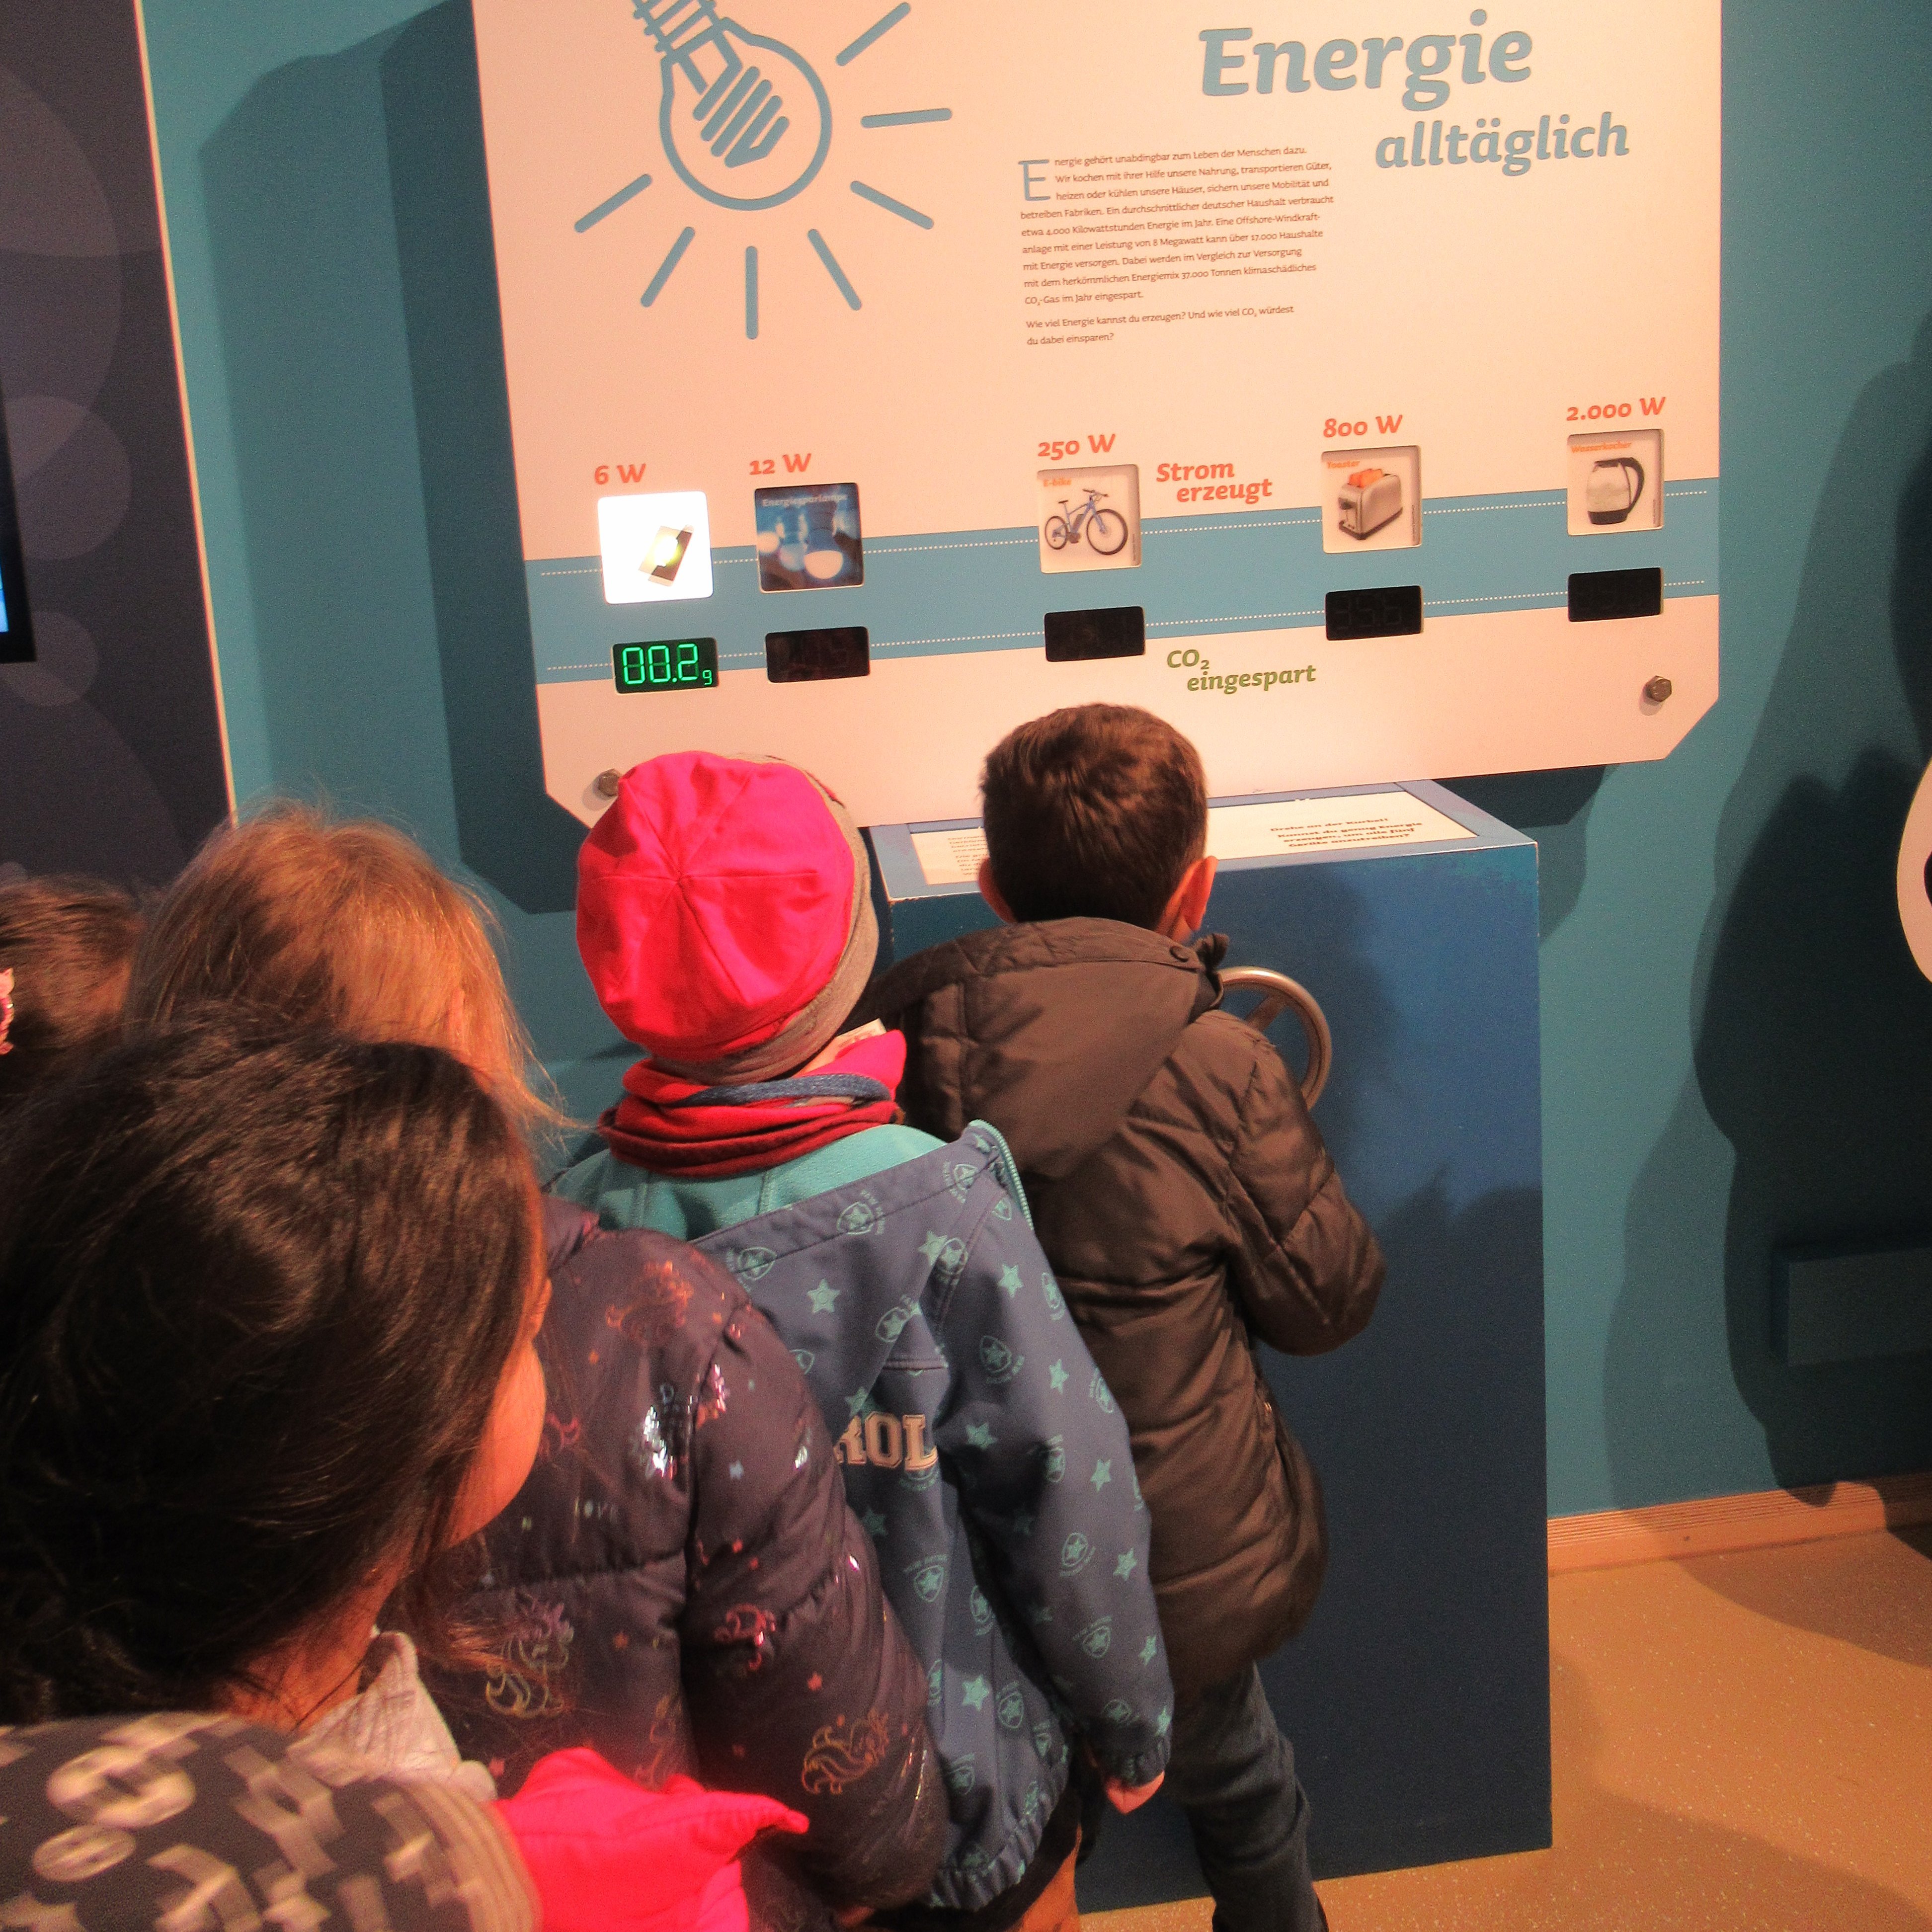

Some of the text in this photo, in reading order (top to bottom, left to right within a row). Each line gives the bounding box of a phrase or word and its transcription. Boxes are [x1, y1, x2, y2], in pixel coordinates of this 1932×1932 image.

[1199, 9, 1532, 111] Energie
[1375, 111, 1629, 176] alltäglich
[1084, 155, 1114, 167] gehört
[1115, 153, 1171, 164] unabdingbar
[1193, 151, 1219, 160] Leben
[1220, 149, 1235, 158] der
[1236, 147, 1282, 157] Menschen
[1283, 146, 1307, 155] dazu.
[1072, 173, 1105, 182] kochen
[1105, 172, 1122, 180] mit
[1145, 169, 1165, 178] Hilfe
[1166, 169, 1197, 178] unsere
[1198, 167, 1239, 177] Nahrung,
[1240, 163, 1304, 174] transportieren
[1305, 161, 1332, 171] Güter,
[1056, 192, 1085, 200] heizen
[1086, 190, 1107, 199] oder
[1108, 189, 1138, 198] kühlen
[1171, 186, 1206, 194] Häuser,
[1207, 184, 1239, 193] sichern
[1271, 180, 1311, 189] Mobilität
[1311, 178, 1330, 187] und
[1020, 195, 1334, 220] betreiben Fabriken. Ein durchschnittlicher deutscher Haushalt verbraucht
[1046, 228, 1071, 236] 4.000
[1072, 222, 1146, 234] Kilowattstunden
[1146, 220, 1180, 231] Energie
[1194, 219, 1214, 229] Jahr.
[1215, 218, 1234, 226] Eine
[1022, 244, 1052, 255] anlage
[1053, 243, 1070, 252] mit
[1095, 241, 1133, 250] Leistung
[1159, 236, 1205, 248] Megawatt
[1205, 235, 1228, 243] kann
[1229, 234, 1249, 242] über
[1251, 233, 1278, 242] 17.000
[1279, 229, 1324, 239] Haushalte
[1023, 262, 1039, 271] mit
[1040, 260, 1073, 271] Energie
[1074, 259, 1120, 269] versorgen.
[1122, 256, 1147, 265] Dabei
[1148, 254, 1182, 263] werden
[1196, 250, 1236, 262] Vergleich
[1252, 248, 1302, 258] Versorgung
[1024, 279, 1040, 288] mit
[1041, 279, 1061, 287] dem
[1062, 274, 1130, 286] herkömmlichen
[1131, 271, 1180, 283] Energiemix
[1181, 271, 1209, 280] 37.000
[1243, 263, 1317, 275] klimaschädliches
[1075, 293, 1093, 303] Jahr
[1094, 291, 1144, 302] eingespart.
[1025, 320, 1043, 328] Wie
[1044, 319, 1061, 327] viel
[1061, 317, 1095, 328] Energie
[1096, 316, 1127, 324] kannst
[1128, 315, 1140, 323] du
[1141, 311, 1187, 323] erzeugen?
[1187, 310, 1206, 320] Und
[1207, 310, 1223, 318] wie
[1224, 308, 1240, 317] viel
[1258, 306, 1294, 315] würdest
[1026, 332, 1115, 345] du dabei einsparen?
[1567, 397, 1666, 421] 2.000 W
[1323, 415, 1403, 438] 800 W
[1038, 434, 1116, 461] 250 W
[594, 464, 646, 485] 6 W
[750, 453, 811, 476] 12 W
[1156, 463, 1234, 482] Strom
[1177, 479, 1272, 504] erzeugt
[622, 644, 698, 684] 00.2
[1187, 665, 1316, 695] eingespart
